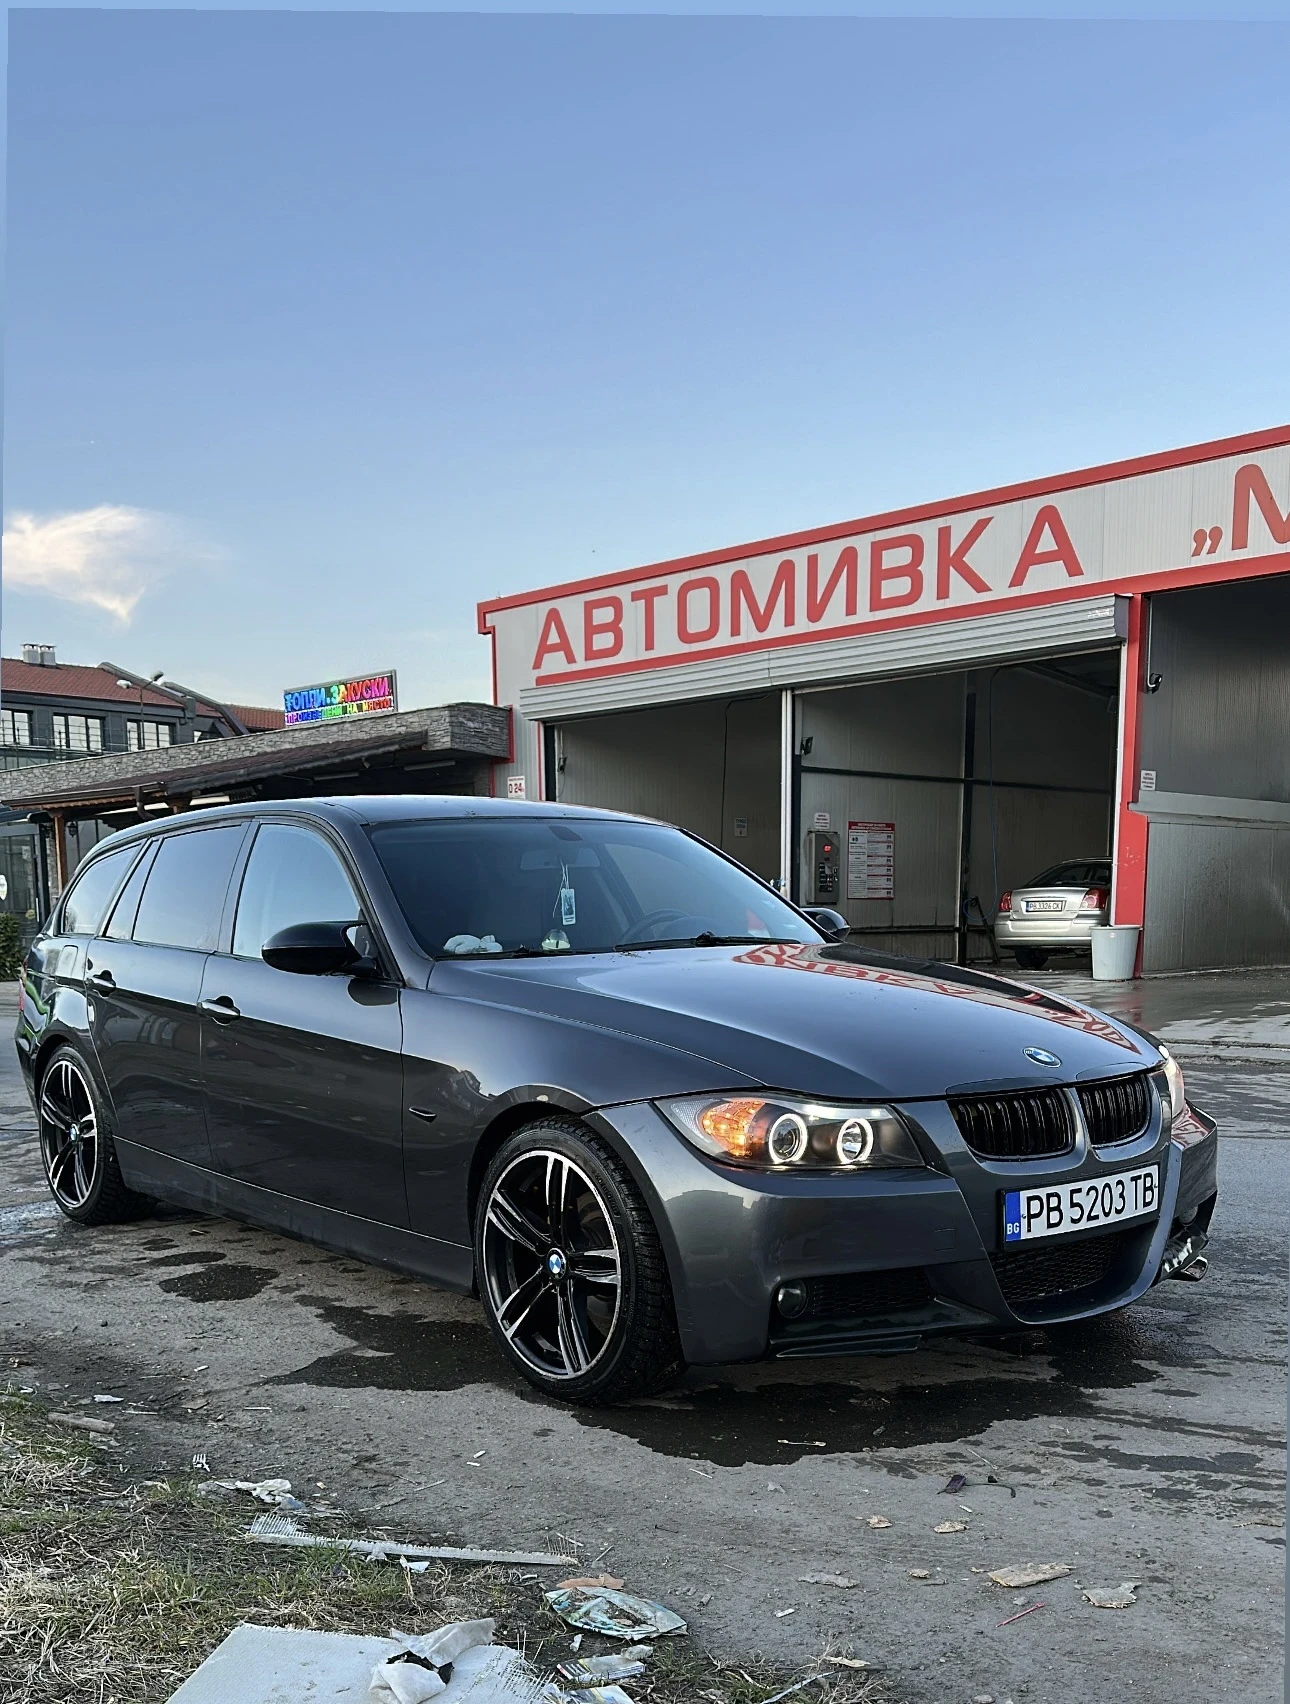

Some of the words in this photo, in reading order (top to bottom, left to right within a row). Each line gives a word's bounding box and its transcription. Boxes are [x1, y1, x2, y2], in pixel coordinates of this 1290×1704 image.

[534, 505, 1083, 669] АВТОМИВКА
[347, 703, 359, 714] НА
[1026, 1192, 1064, 1233] PB
[1069, 1179, 1126, 1225] 5203
[1130, 1172, 1155, 1211] TB
[1006, 1222, 1020, 1235] BG
